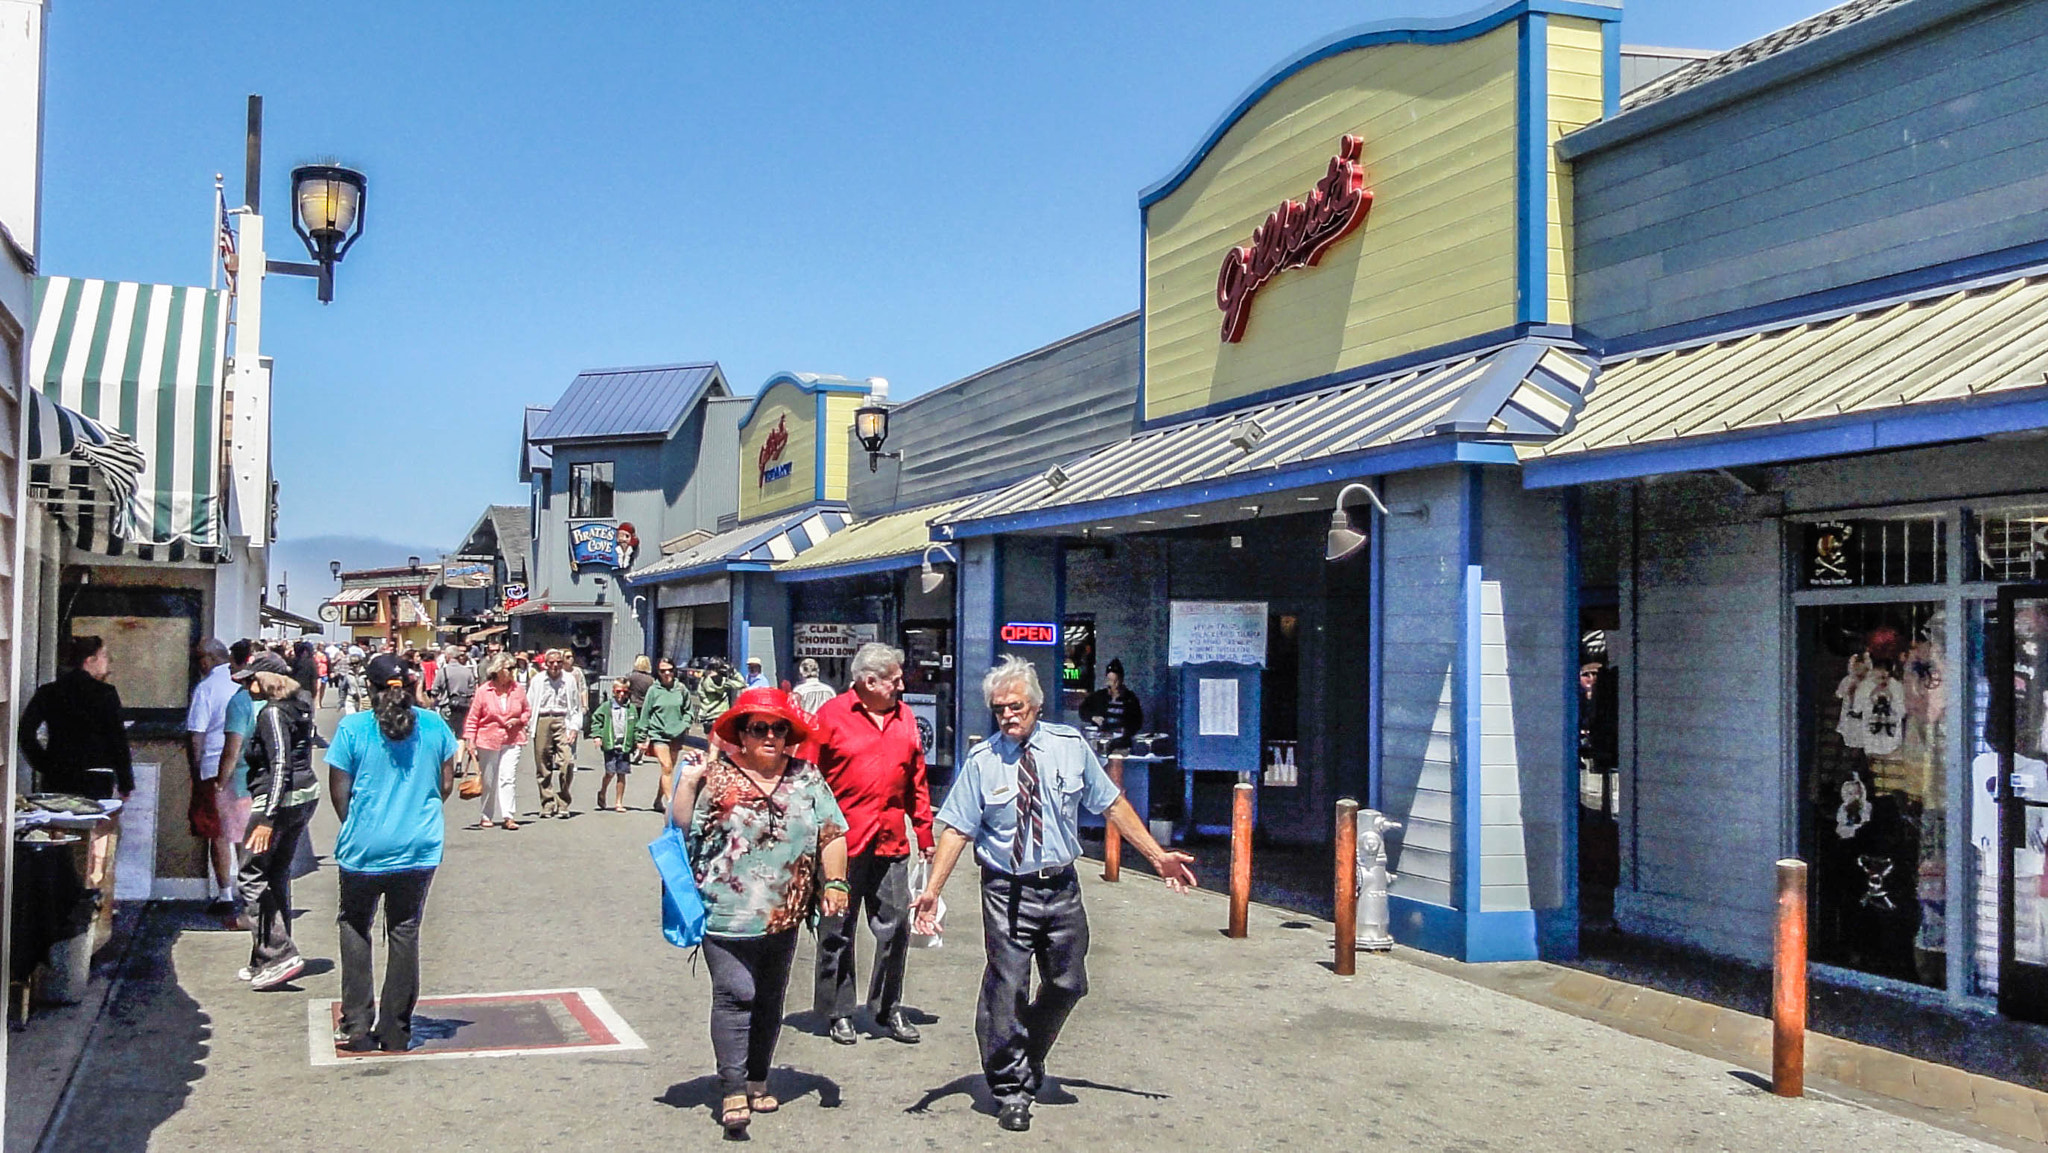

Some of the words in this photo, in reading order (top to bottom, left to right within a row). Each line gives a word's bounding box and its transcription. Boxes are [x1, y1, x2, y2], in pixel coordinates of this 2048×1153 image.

[572, 527, 615, 545] PIRATE'S
[587, 540, 613, 553] COVE
[809, 625, 838, 634] CLAM
[1001, 625, 1053, 641] OPEN
[798, 636, 849, 645] CHOWDER
[797, 647, 803, 656] A
[805, 647, 834, 656] BREAD
